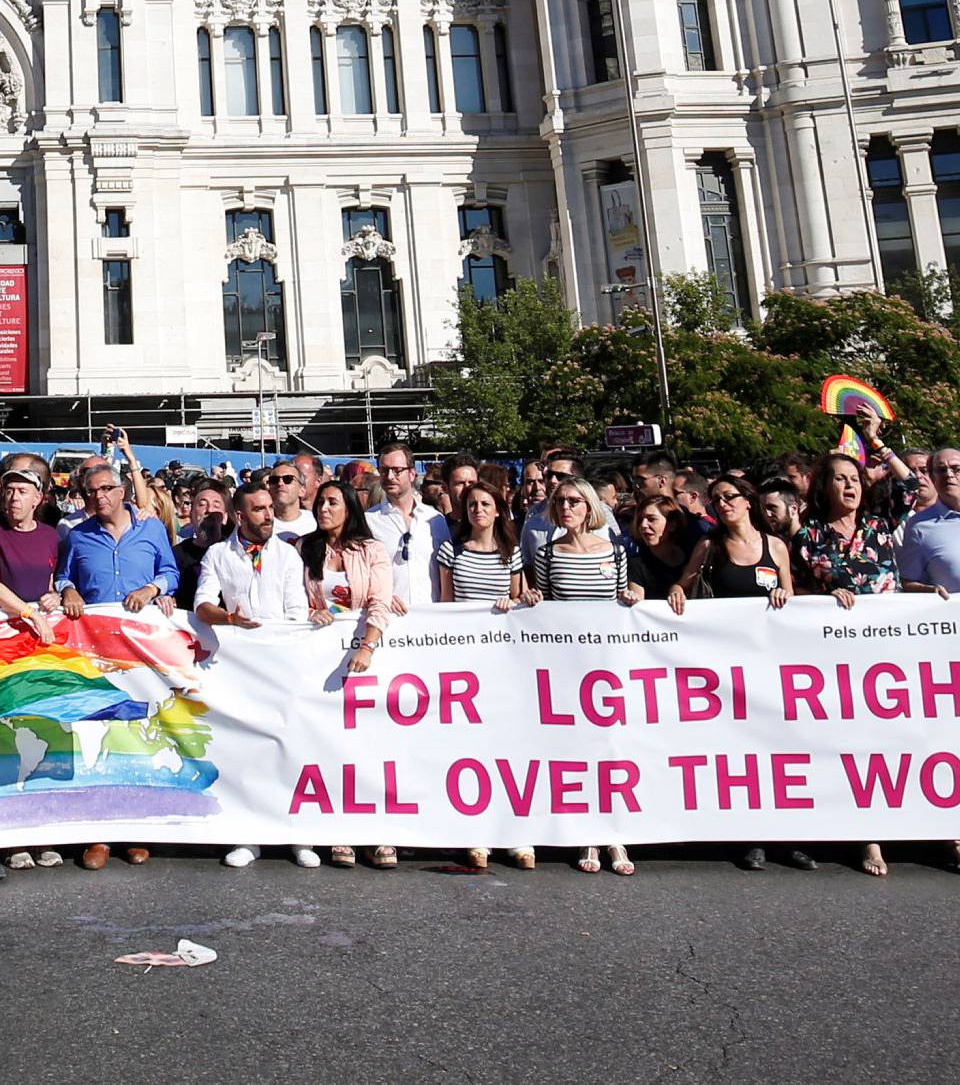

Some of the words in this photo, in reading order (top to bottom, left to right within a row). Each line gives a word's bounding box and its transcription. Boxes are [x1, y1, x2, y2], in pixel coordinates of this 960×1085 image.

[341, 634, 384, 650] LGI
[388, 631, 476, 648] eskubideen
[480, 630, 517, 644] alde,
[521, 631, 573, 645] hemen
[578, 632, 602, 645] eta
[607, 629, 679, 645] munduan
[823, 626, 857, 639] Pels
[862, 625, 901, 638] drets
[907, 621, 957, 636] LGTBI
[342, 671, 483, 729] FOR
[536, 666, 747, 728] LGTBI
[288, 760, 420, 815] ALL
[445, 757, 642, 817] OVER
[668, 753, 814, 810] THE
[839, 751, 960, 809] WO
